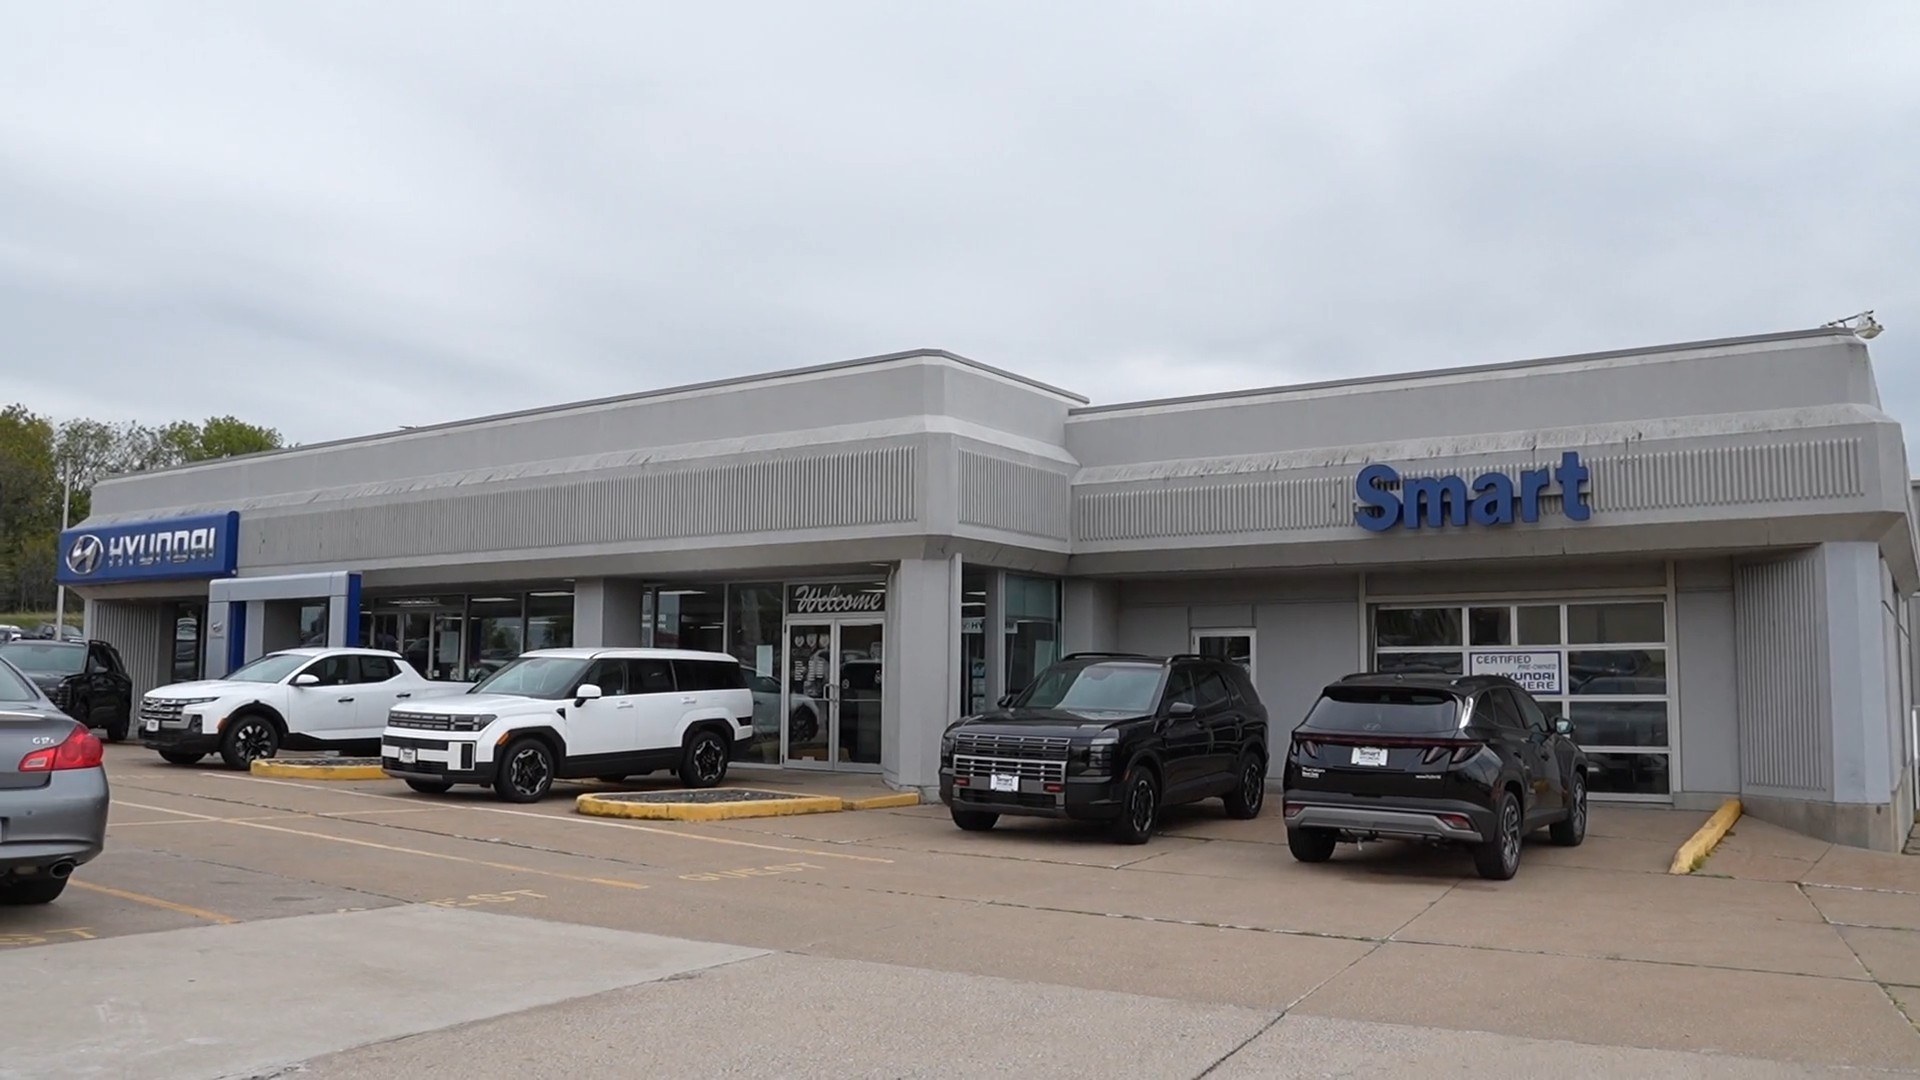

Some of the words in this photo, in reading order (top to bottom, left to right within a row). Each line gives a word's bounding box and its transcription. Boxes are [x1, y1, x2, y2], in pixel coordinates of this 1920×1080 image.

[1354, 451, 1591, 532] Smart
[108, 527, 216, 567] HYUNDAI
[795, 585, 882, 612] Welcome
[1476, 655, 1532, 664] CERTIFIED
